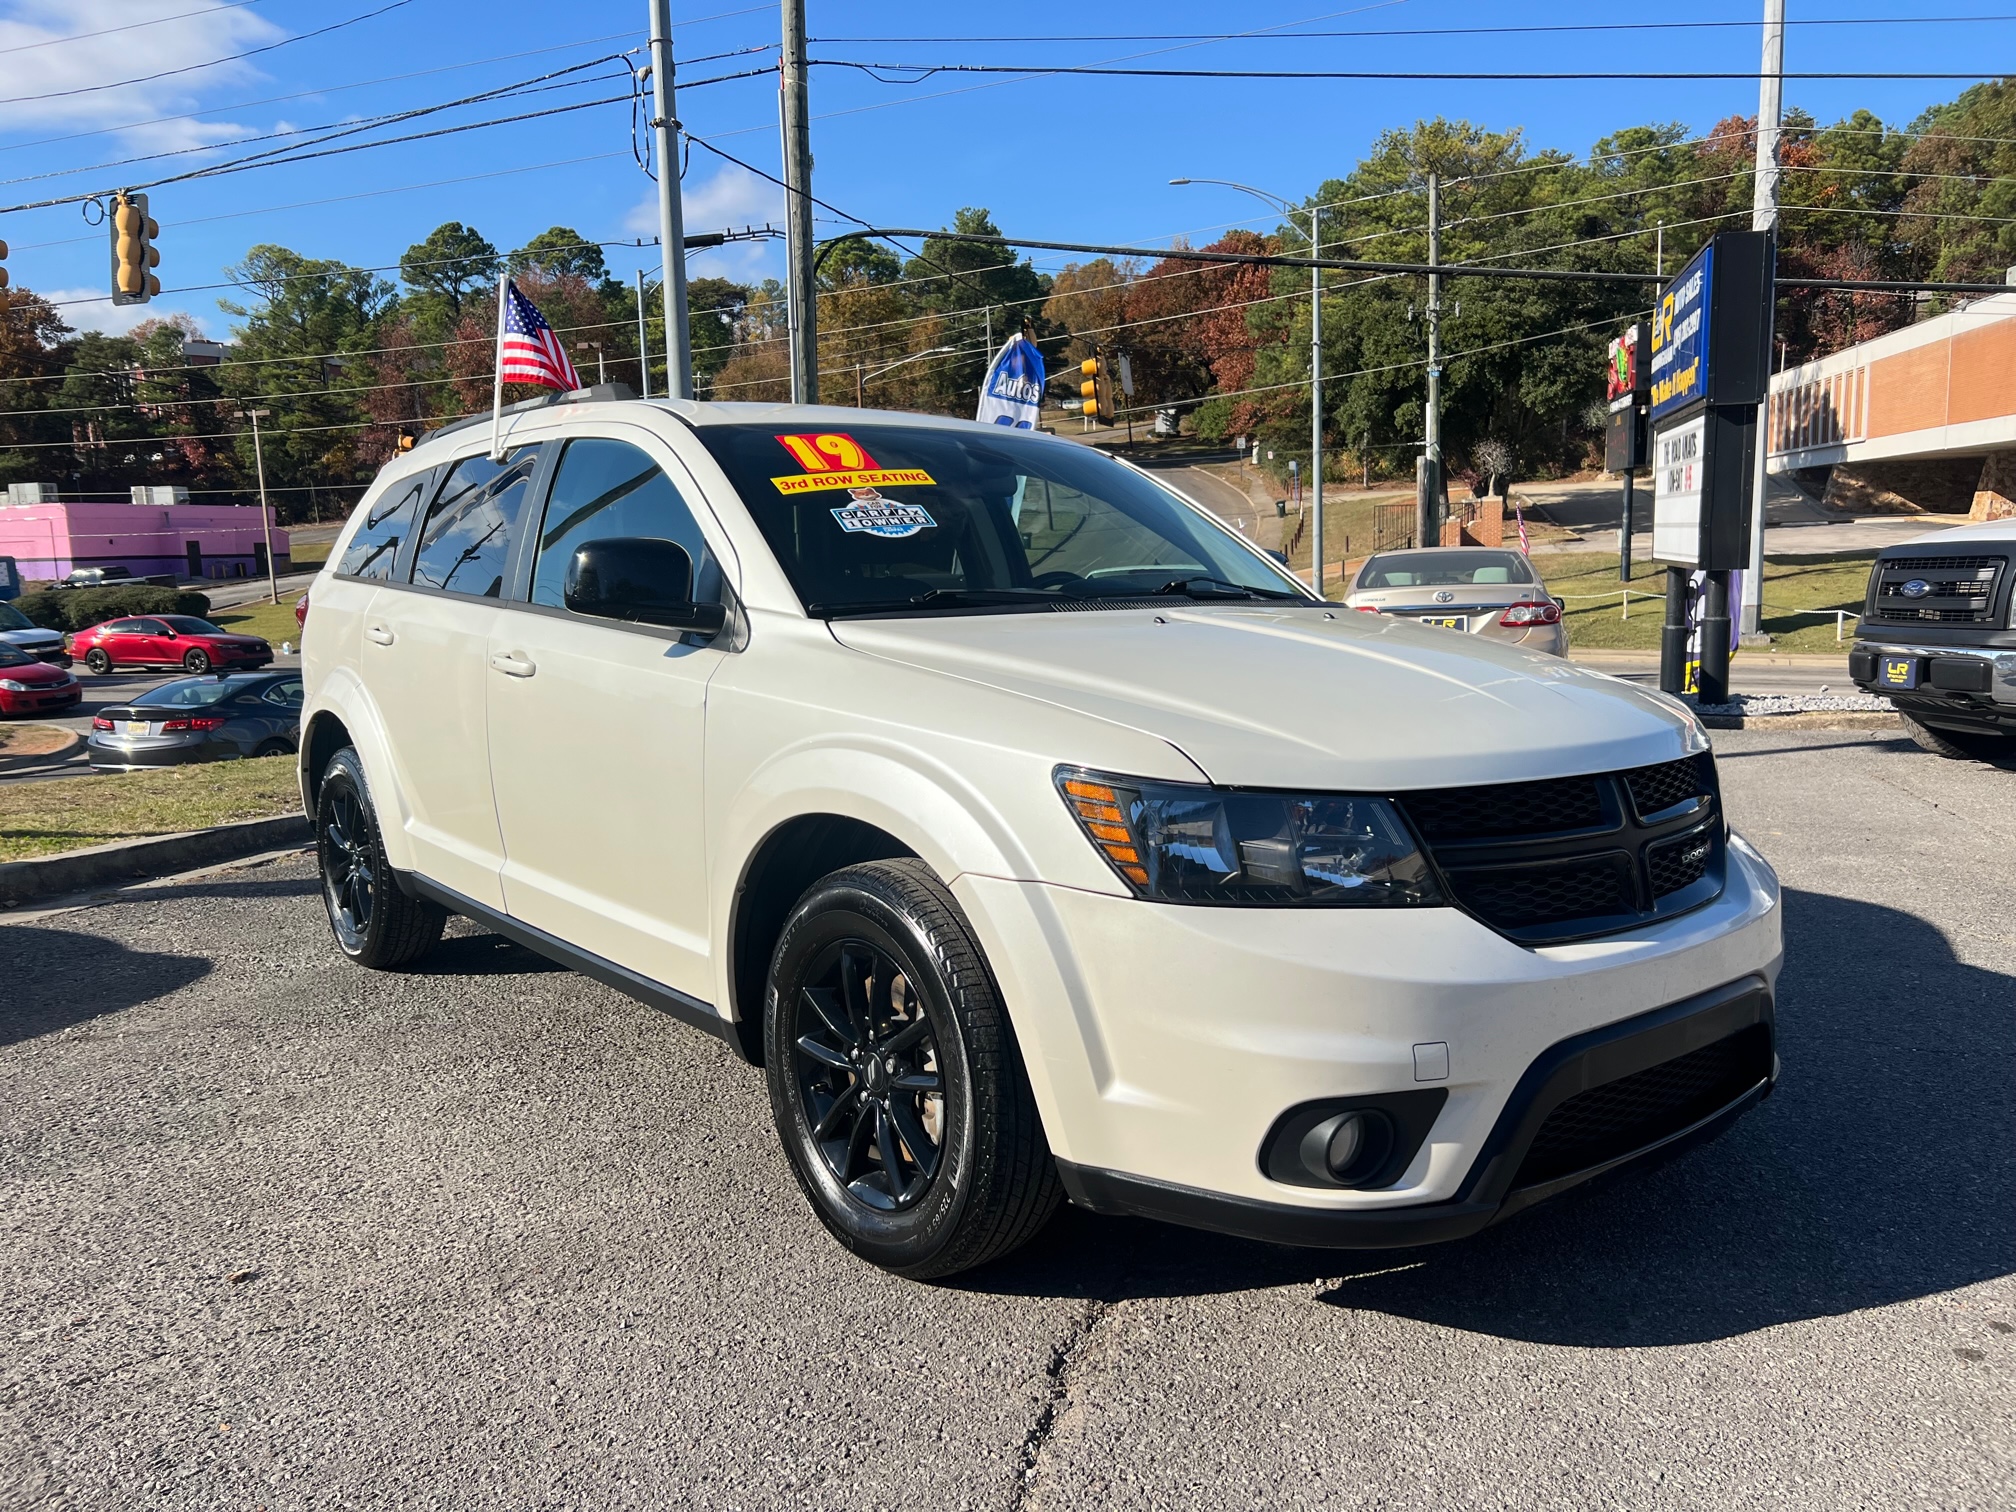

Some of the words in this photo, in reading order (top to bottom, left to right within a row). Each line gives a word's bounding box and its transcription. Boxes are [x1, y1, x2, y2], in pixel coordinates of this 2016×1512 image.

[992, 371, 1040, 404] Autos
[783, 434, 864, 472] 19
[780, 478, 809, 492] 3rd
[812, 475, 853, 488] ROW
[859, 472, 930, 484] SEATING
[840, 510, 922, 519] CARFAX
[860, 517, 928, 527] OWNER
[1887, 662, 1909, 675] LR
[932, 1190, 951, 1230] 225/65
